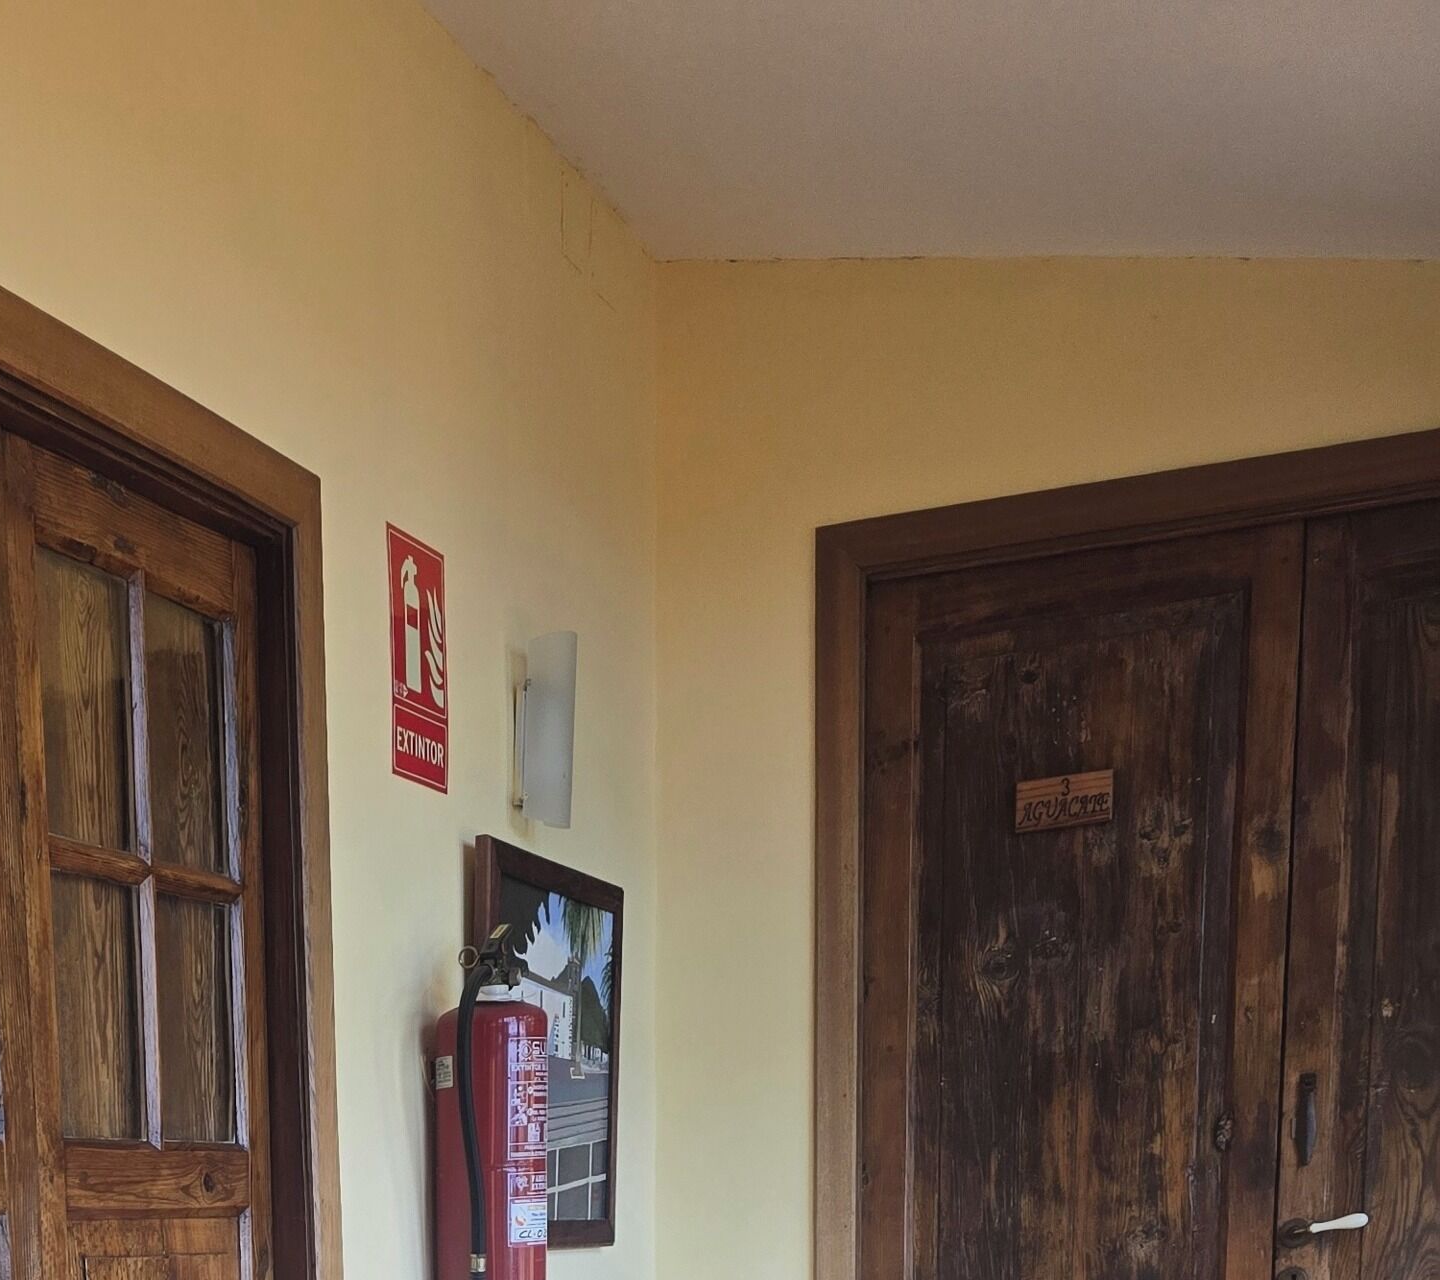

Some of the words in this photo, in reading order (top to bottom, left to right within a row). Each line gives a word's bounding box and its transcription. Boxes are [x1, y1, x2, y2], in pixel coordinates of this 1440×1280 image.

[397, 726, 444, 768] EXTINTOR
[1061, 778, 1070, 796] 3
[1019, 792, 1110, 826] AGUACATE
